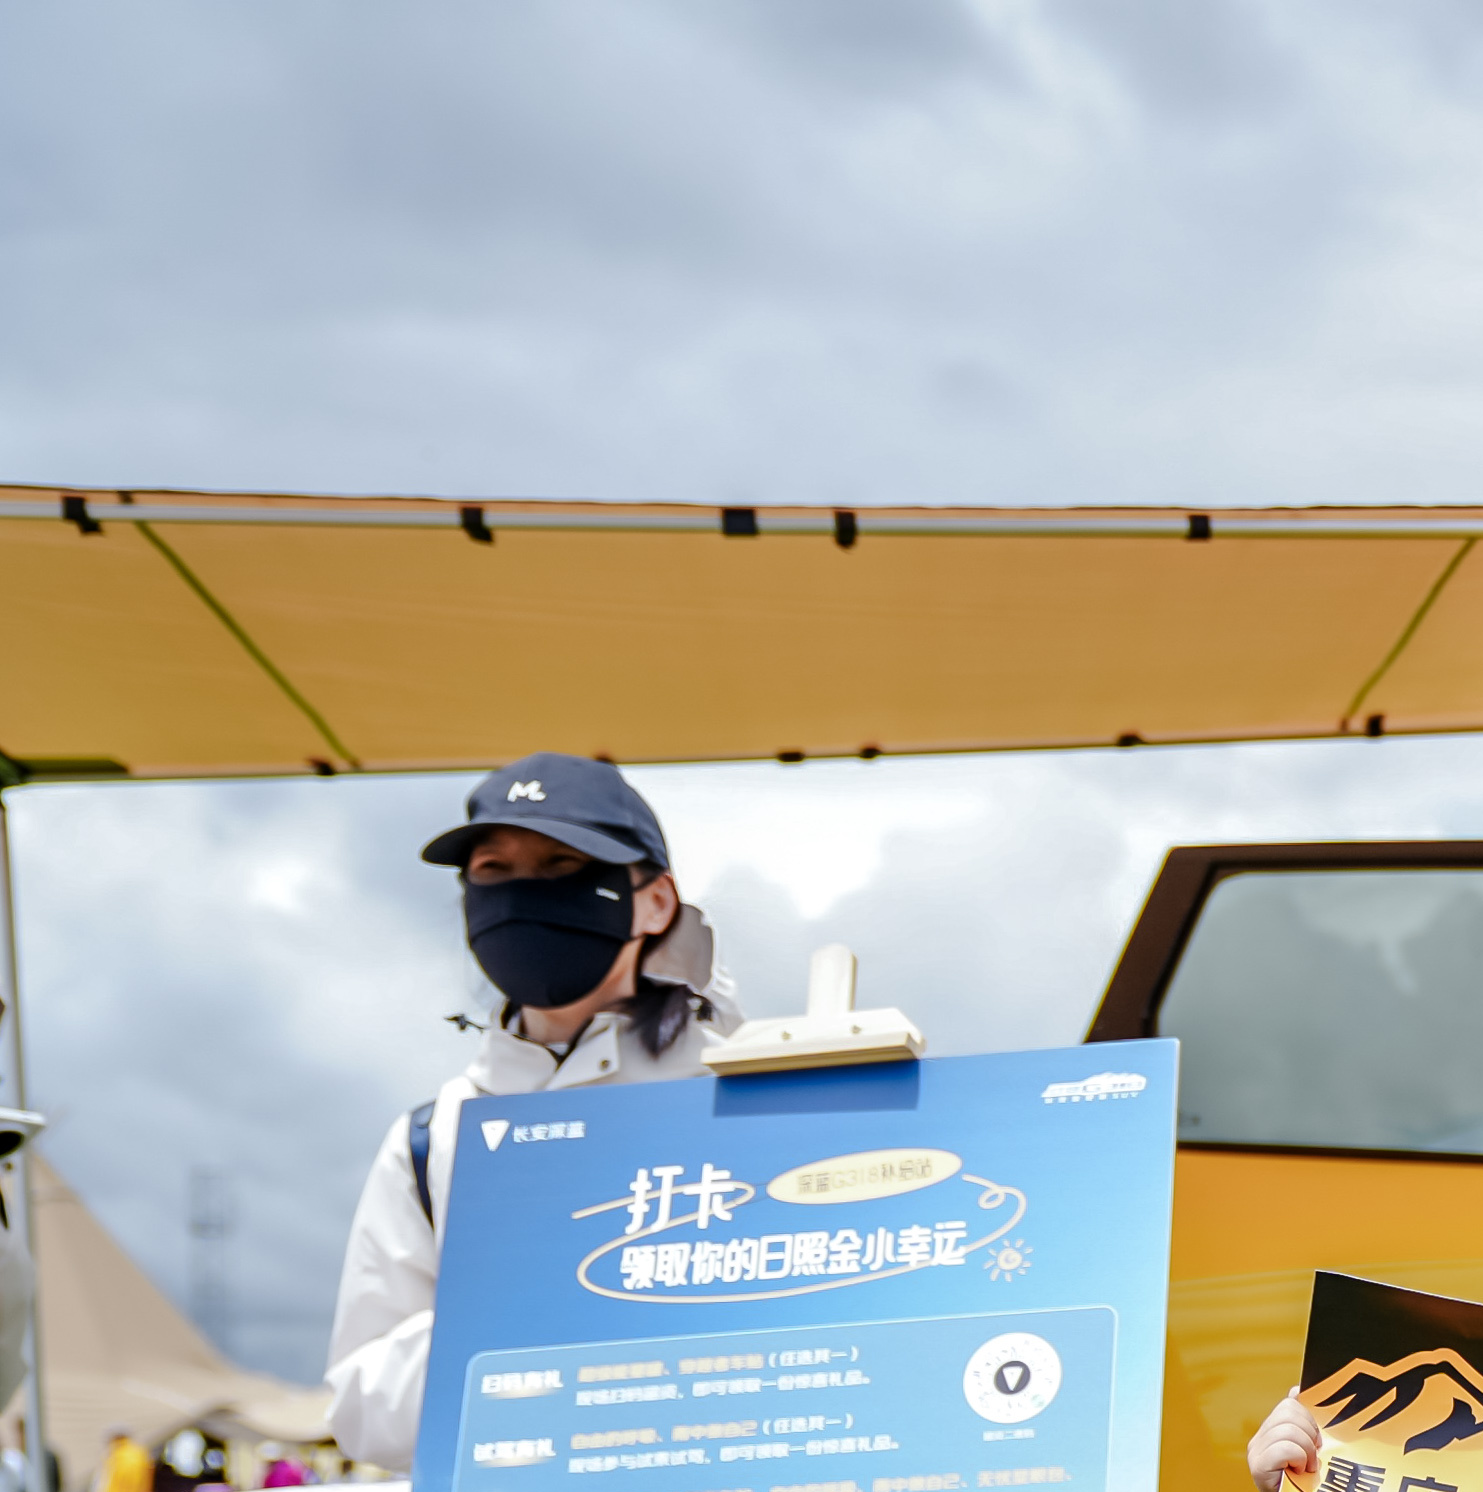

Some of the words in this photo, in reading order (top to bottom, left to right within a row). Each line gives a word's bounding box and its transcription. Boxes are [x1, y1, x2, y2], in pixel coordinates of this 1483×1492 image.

[625, 1163, 735, 1235] 打卡
[620, 1220, 968, 1290] 领取你的日照金小幸运
